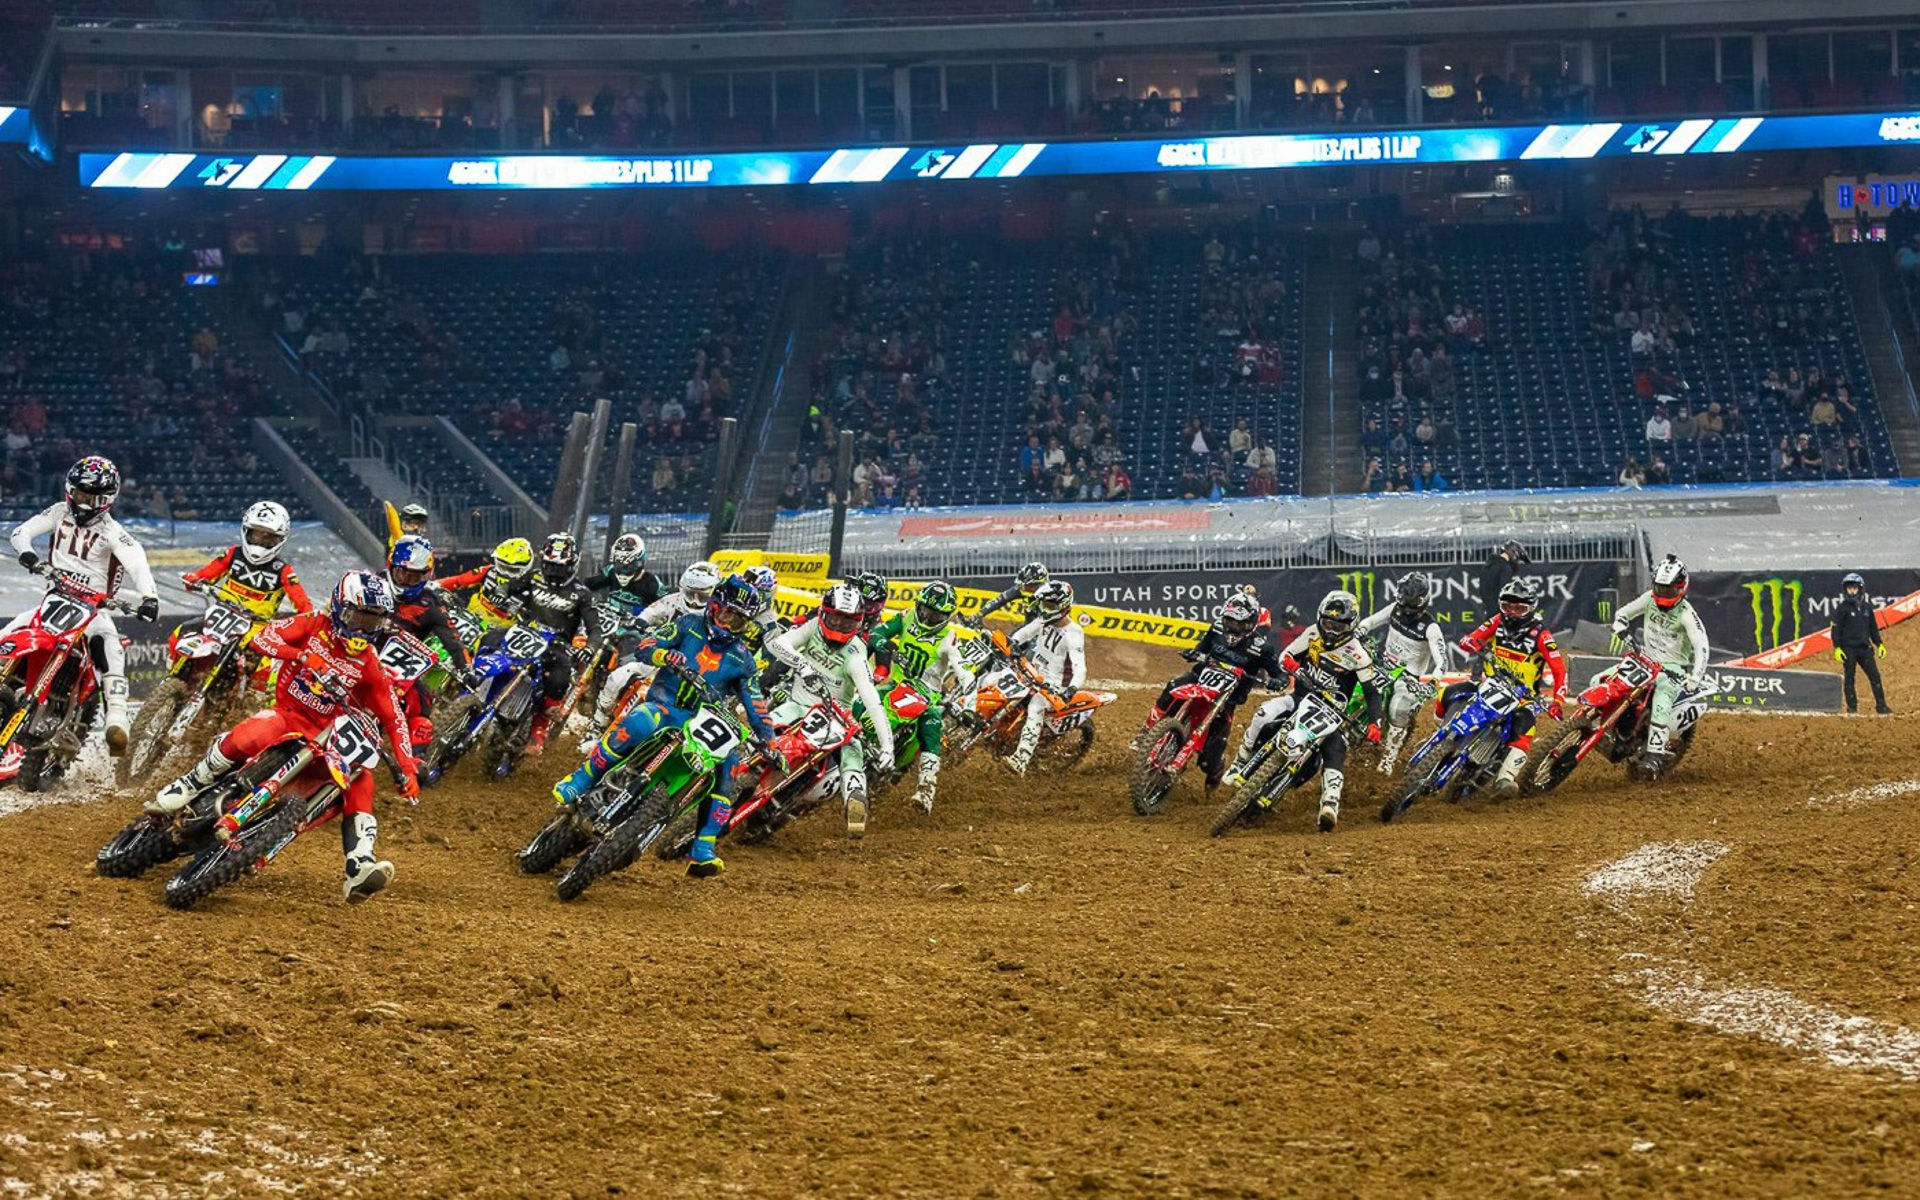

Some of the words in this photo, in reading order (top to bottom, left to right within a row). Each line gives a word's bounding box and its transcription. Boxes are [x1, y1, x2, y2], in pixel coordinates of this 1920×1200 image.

[55, 519, 100, 560] FLY
[229, 559, 278, 590] FXR
[773, 561, 823, 574] DUNLOP
[1094, 587, 1151, 602] UTAH
[1162, 584, 1243, 600] SPORTS
[41, 600, 84, 631] 10
[381, 646, 422, 680] 94
[1619, 660, 1650, 684] 20
[998, 674, 1026, 697] 81
[892, 693, 919, 708] 1
[1677, 705, 1698, 729] 20
[336, 720, 374, 767] 51
[693, 717, 732, 751] 9
